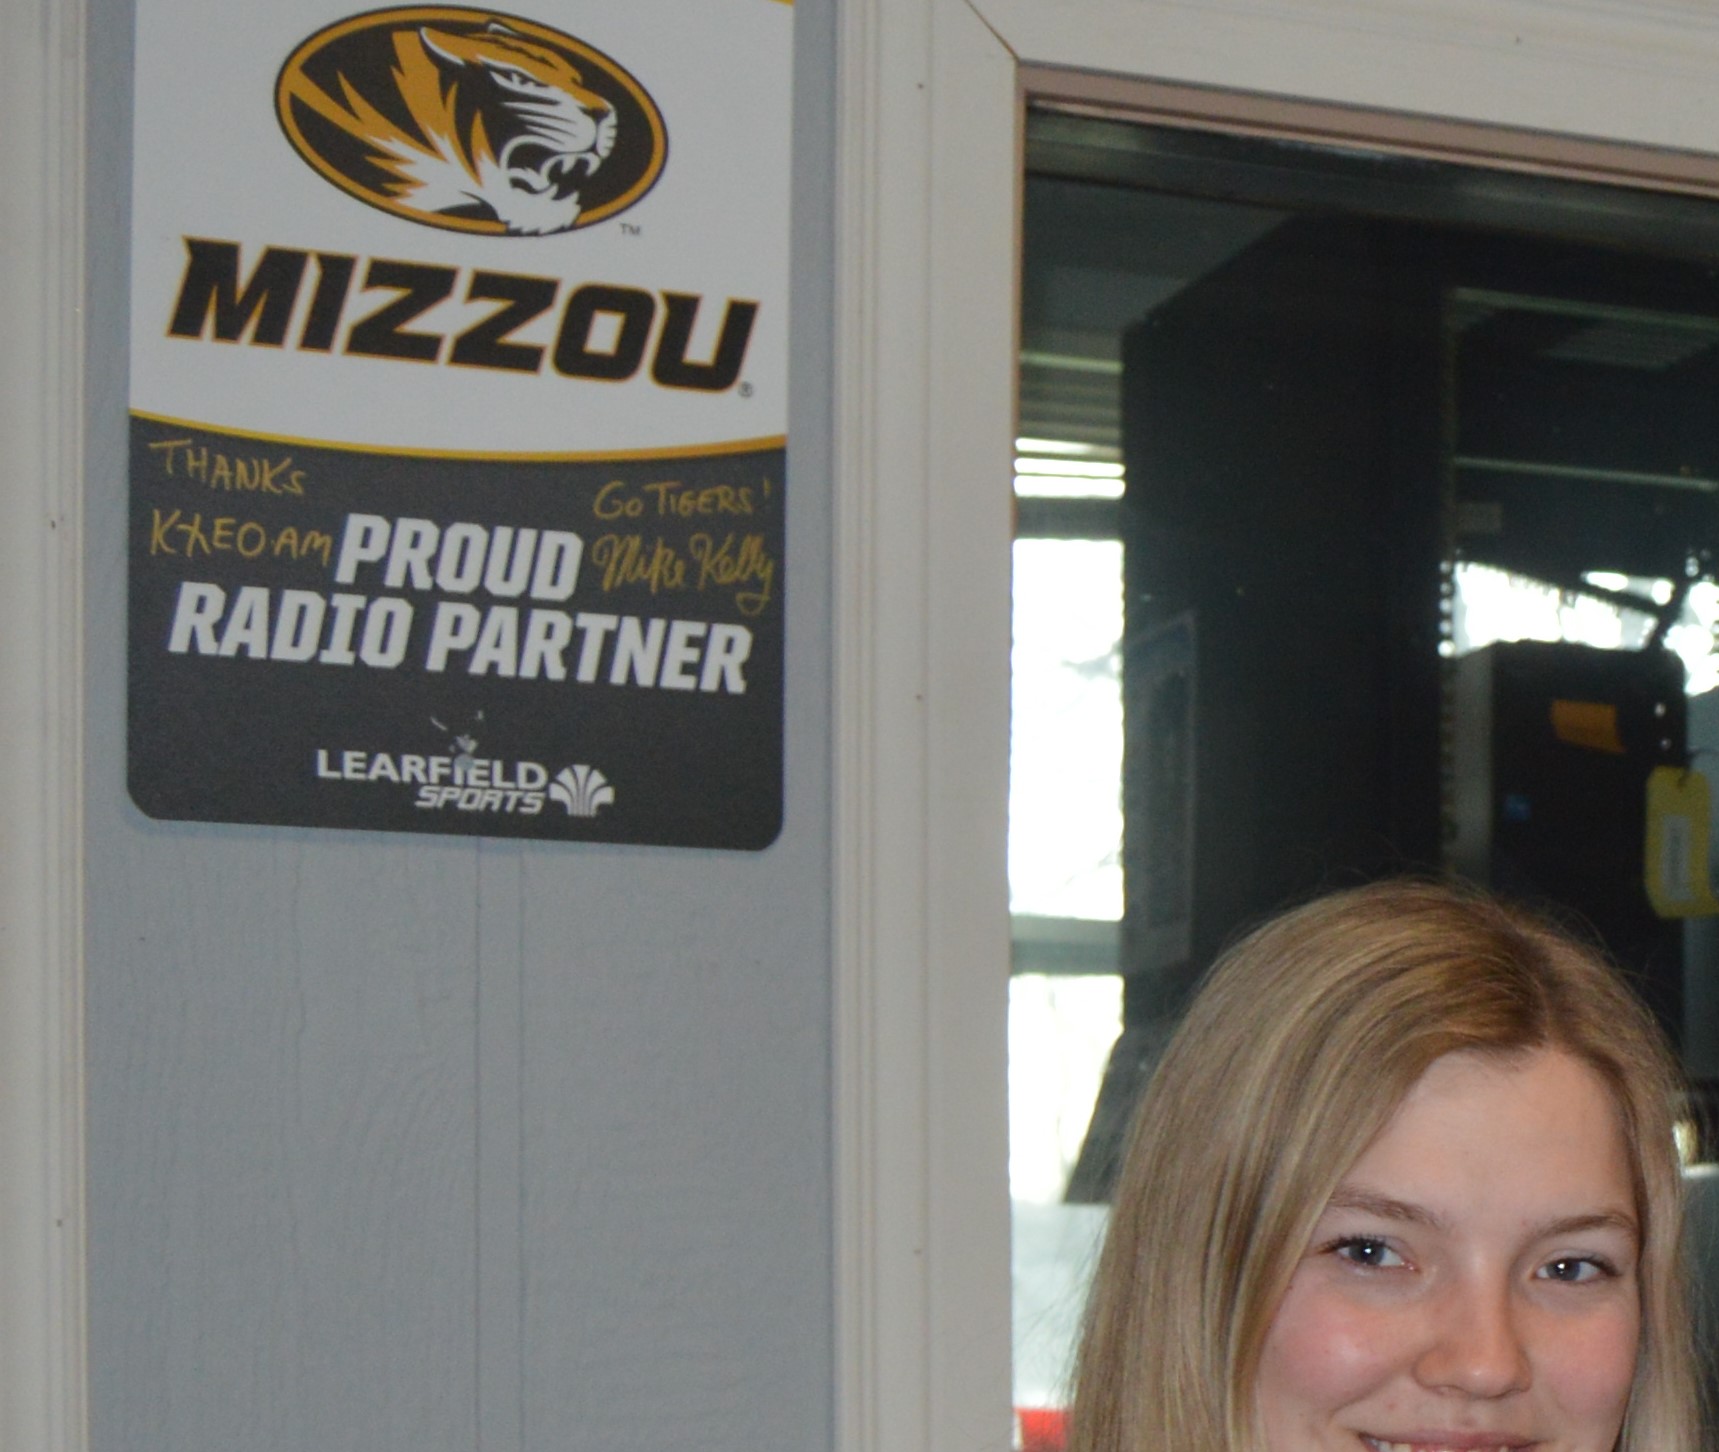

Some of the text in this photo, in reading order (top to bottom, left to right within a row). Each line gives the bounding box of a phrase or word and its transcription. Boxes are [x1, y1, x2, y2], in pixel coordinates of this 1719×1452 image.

[165, 235, 761, 396] MIZZOU
[147, 438, 307, 496] THANKS
[334, 513, 584, 604] PROUD
[167, 581, 755, 696] RADIO PARTNER
[316, 748, 548, 793] LEARFIELD
[414, 784, 547, 816] SPORTS
